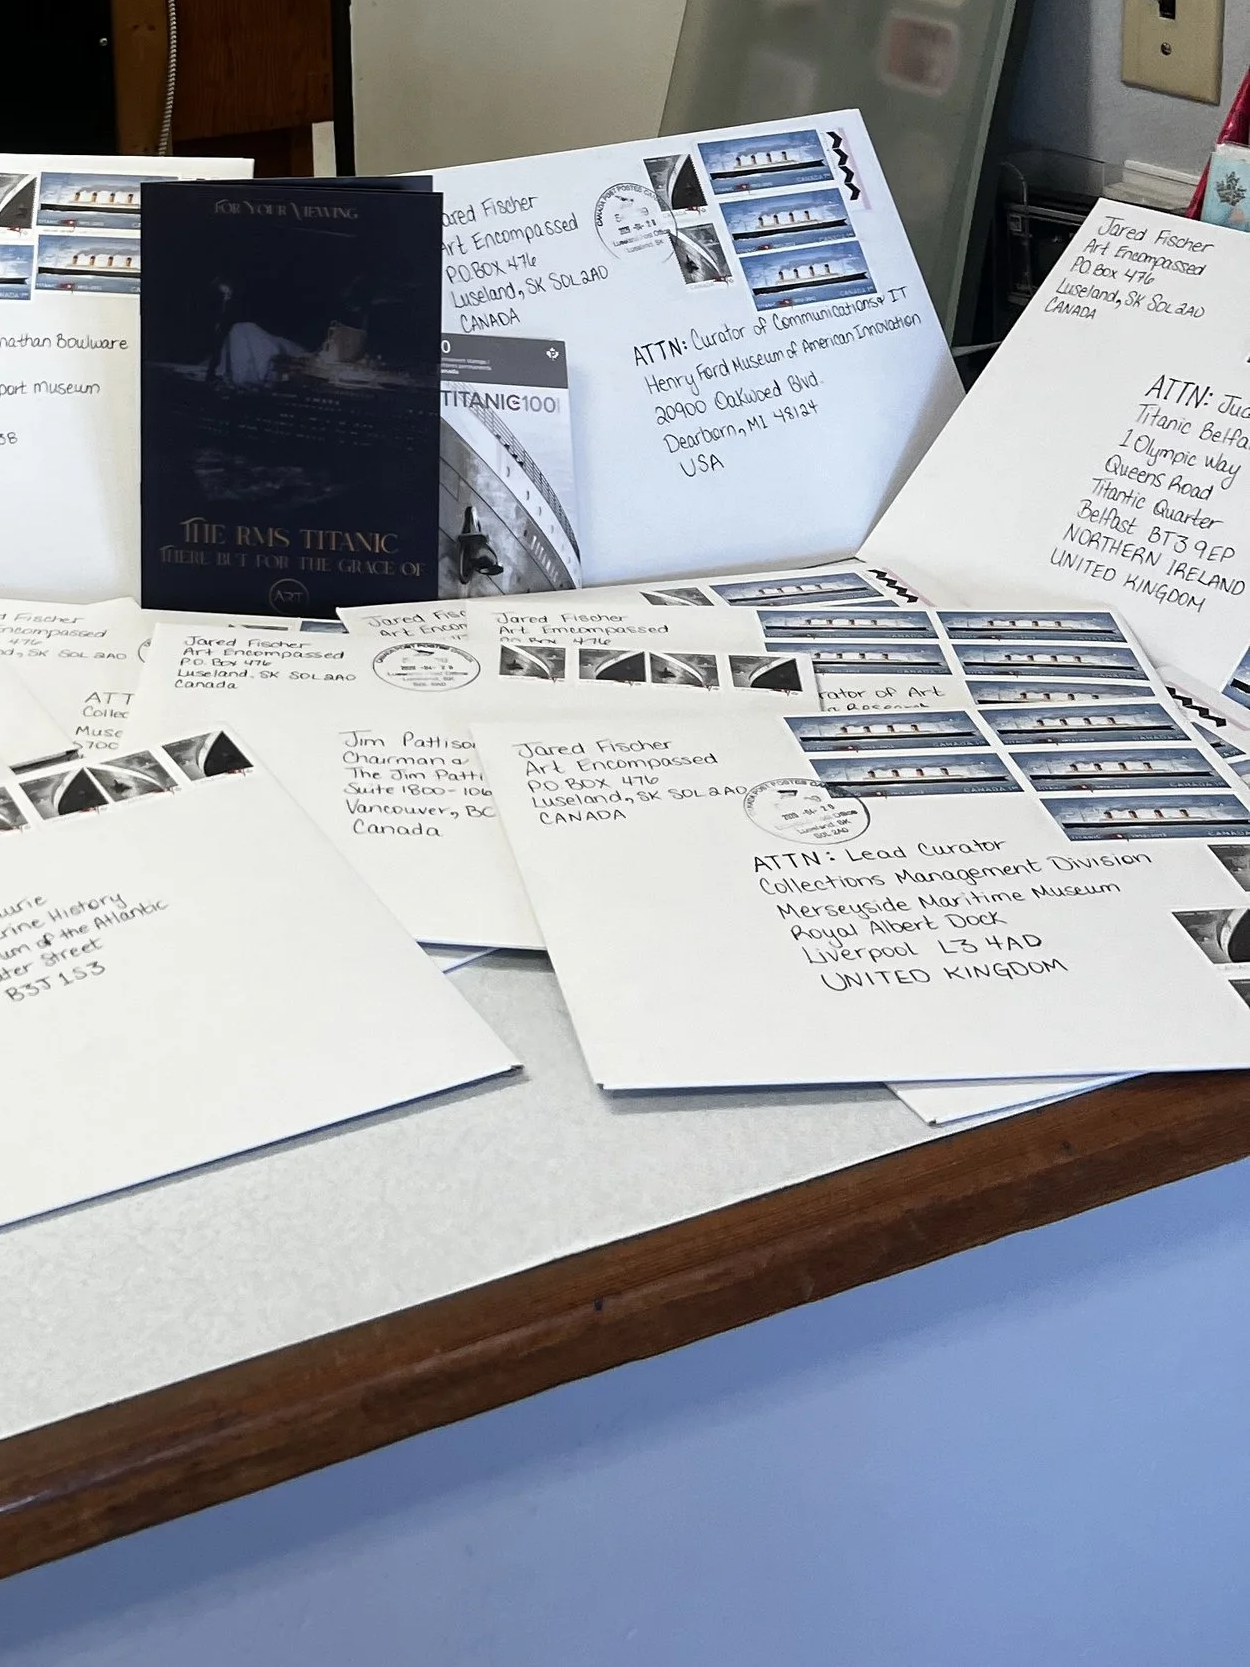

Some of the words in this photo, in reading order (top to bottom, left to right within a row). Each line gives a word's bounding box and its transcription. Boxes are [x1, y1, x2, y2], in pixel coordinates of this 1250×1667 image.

[1098, 215, 1148, 241] Jared
[1154, 229, 1215, 253] Fischer
[1083, 238, 1110, 256] Art
[1113, 245, 1208, 276] Encompassed
[1055, 277, 1122, 310] Luseland,
[1124, 290, 1147, 308] SK
[1124, 268, 1155, 285] 476
[1044, 295, 1098, 321] CANADA
[56, 333, 129, 351] Boulware
[632, 337, 688, 367] ATTN:
[690, 324, 746, 352] Curator
[753, 316, 768, 336] of
[888, 286, 908, 302] IT
[644, 374, 700, 397] Henry
[696, 359, 730, 381] Ford
[732, 350, 785, 373] Museum
[786, 344, 798, 359] of
[802, 332, 854, 354] American
[852, 312, 922, 340] Innovation
[654, 399, 708, 426] 20900
[714, 379, 784, 410] Oakwood
[1144, 374, 1215, 409] ATTN:
[662, 422, 746, 454] Dearborn,
[746, 415, 769, 432] MI
[772, 398, 820, 423] 48124
[1135, 403, 1193, 436] Titanic
[679, 453, 724, 478] USA
[1104, 454, 1166, 488] Queens
[1167, 474, 1214, 502] Road
[1133, 433, 1198, 467] Olympic
[1204, 451, 1242, 490] Way
[1076, 498, 1138, 536] Belfast
[1147, 526, 1189, 554] BT3
[1194, 539, 1236, 563] 9EP
[1152, 498, 1225, 530] Quarter
[179, 516, 226, 545] THE
[235, 524, 290, 548] RMS
[300, 529, 399, 555] TITANIC
[159, 544, 208, 566] THERE
[217, 552, 248, 567] BUT
[256, 554, 289, 569] FOR
[300, 556, 331, 573] THE
[338, 559, 395, 576] GRACE
[401, 562, 426, 577] OF
[1062, 523, 1163, 567] NORTHERN
[1165, 558, 1246, 596] IRELAND
[274, 589, 303, 603] ART
[1049, 545, 1117, 583] UNITED
[1123, 573, 1207, 614] KINGDOM
[338, 729, 385, 748] Jim
[342, 750, 445, 765] Chairman
[346, 798, 459, 819] Vancouver,
[465, 805, 496, 818] BC
[353, 818, 443, 837] Canada
[754, 851, 836, 873] ATTN:
[844, 846, 907, 862] Lead
[917, 839, 1006, 857] Curator
[759, 874, 886, 896] Collections
[895, 858, 1042, 886] Management
[1046, 852, 1152, 871] Division
[48, 893, 128, 923] History
[776, 896, 911, 920] Merseyside
[918, 888, 1026, 910] Maritime
[1031, 883, 1121, 899] Museum
[36, 932, 55, 949] of
[59, 923, 90, 940] the
[93, 899, 169, 930] Atlantic
[790, 923, 859, 950] Royal
[870, 915, 939, 935] Albert
[944, 911, 1008, 929] Dock
[40, 937, 103, 968] Street
[802, 941, 919, 964] Liverpool
[937, 938, 978, 954] L3
[985, 933, 1043, 951] 4AD
[4, 976, 52, 1002] B3J
[59, 960, 106, 986] 1S3
[820, 968, 931, 991] UNITED
[943, 958, 1069, 980] KINGDOM
